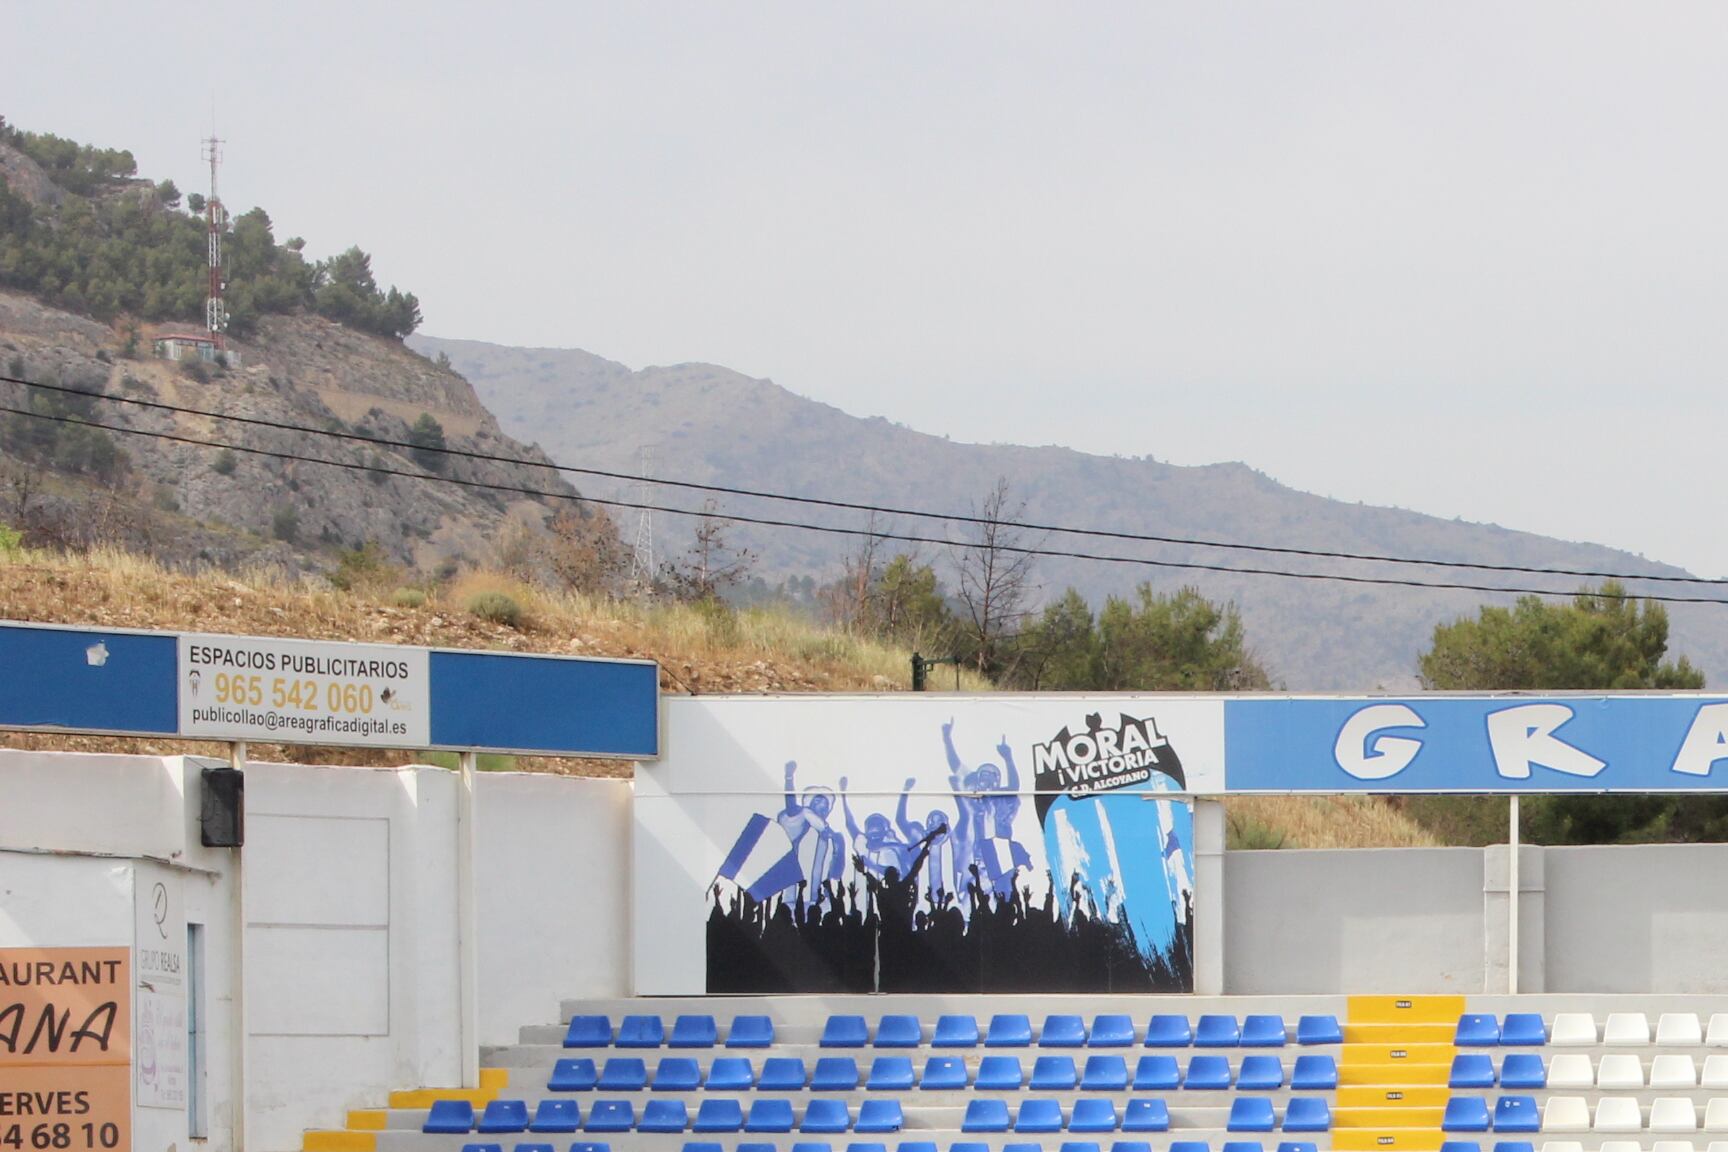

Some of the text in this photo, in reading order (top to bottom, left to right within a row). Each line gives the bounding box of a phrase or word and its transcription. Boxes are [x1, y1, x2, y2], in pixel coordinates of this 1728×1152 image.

[190, 645, 409, 680] ESPACIOS PUBLICITARIOS
[215, 672, 373, 715] 965 542 060
[192, 706, 407, 737] publicollao@areagraficadigital.es
[1034, 718, 1167, 775] MORAL
[1093, 770, 1149, 791] ALCOYANO
[31, 1123, 71, 1150] 68
[81, 1122, 119, 1149] 10
